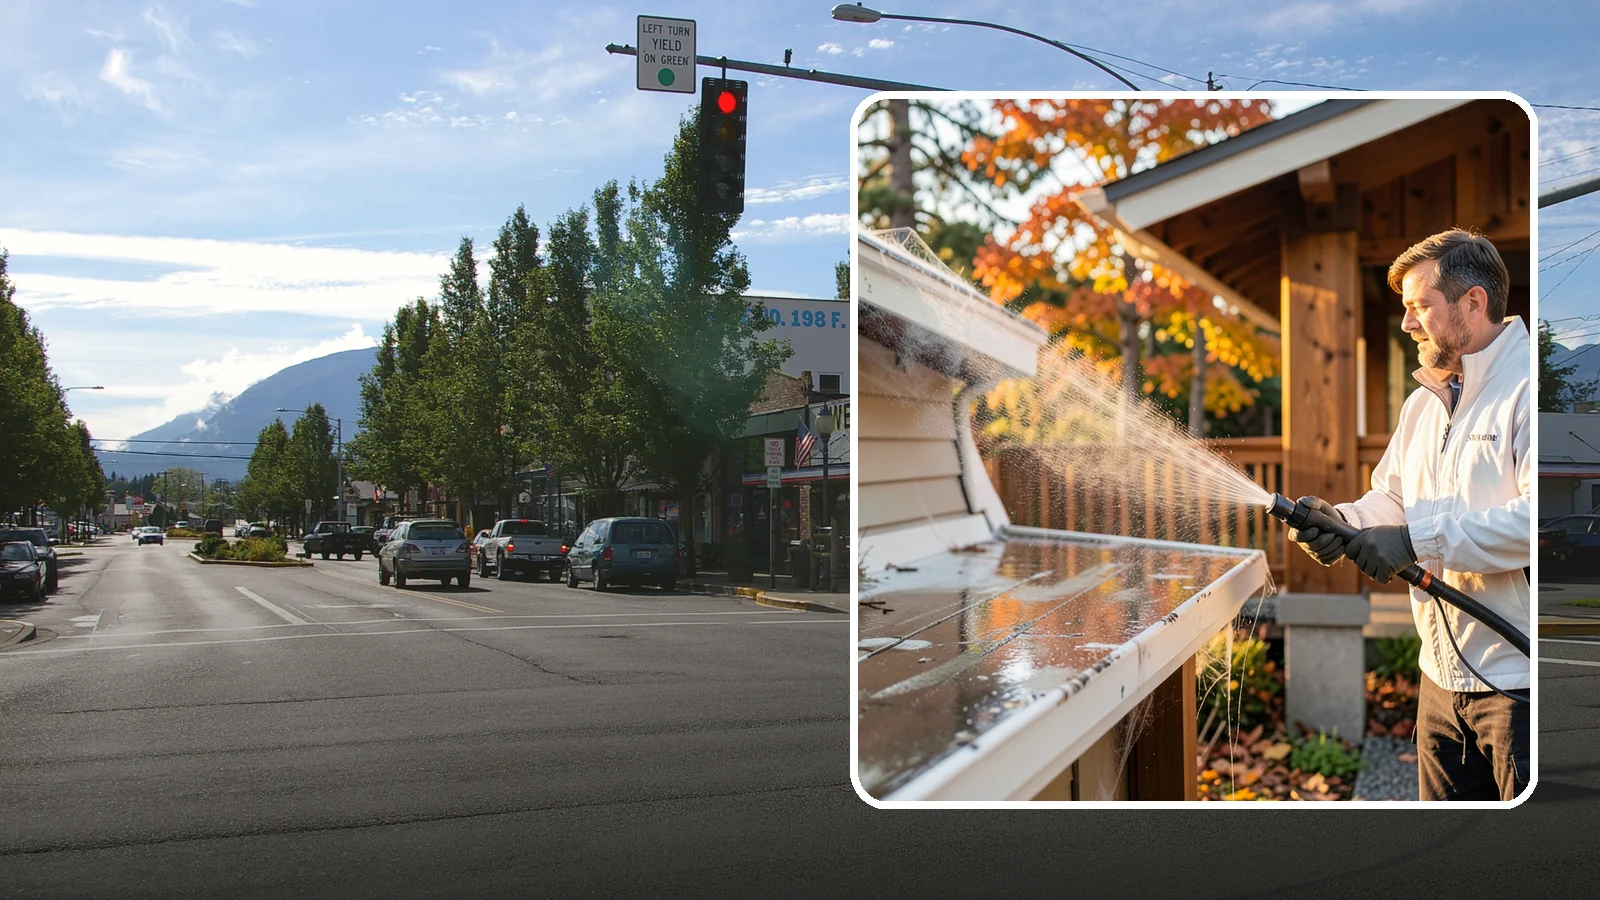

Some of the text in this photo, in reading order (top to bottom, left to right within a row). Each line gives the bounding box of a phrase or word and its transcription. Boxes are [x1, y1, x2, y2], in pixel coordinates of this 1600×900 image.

[643, 24, 690, 36] LEFT TURN
[652, 38, 682, 51] YIELD
[644, 53, 688, 66] ON GREEN
[791, 309, 826, 328] 198
[831, 311, 846, 329] F.
